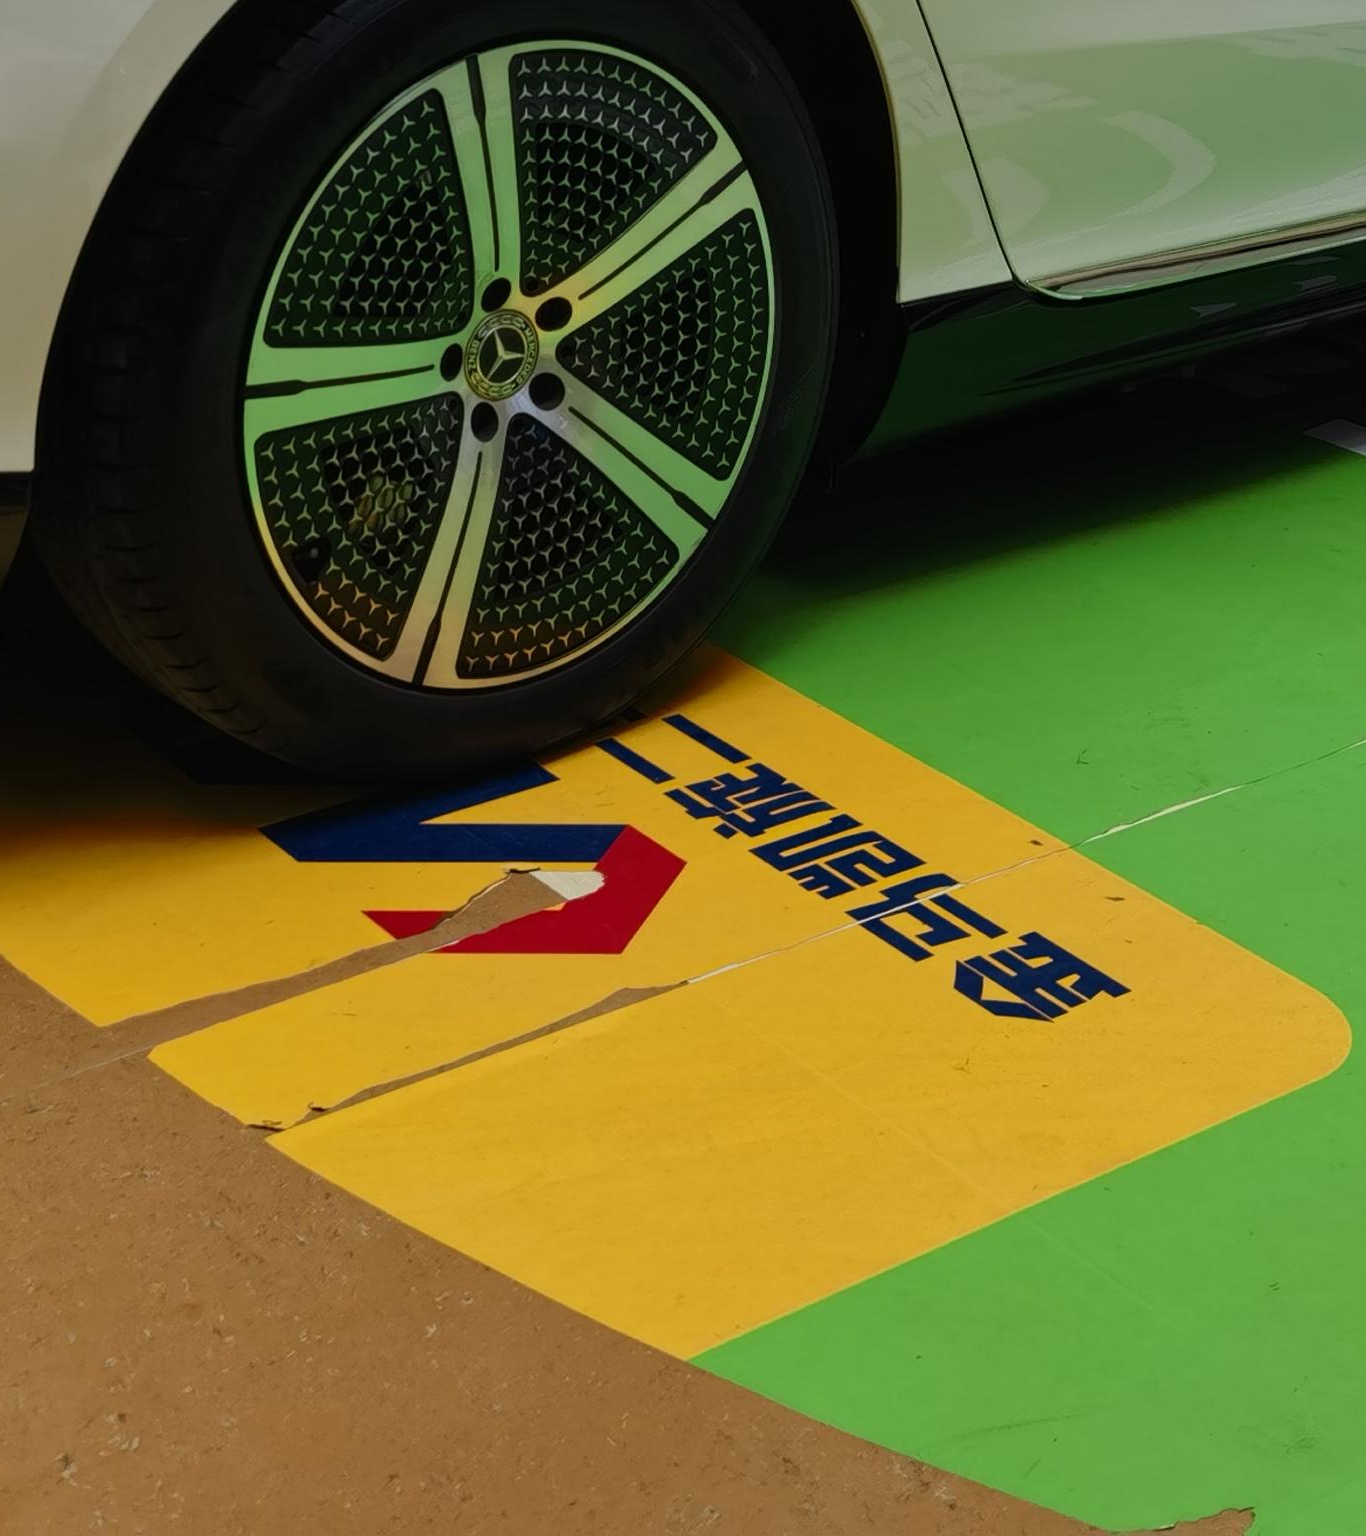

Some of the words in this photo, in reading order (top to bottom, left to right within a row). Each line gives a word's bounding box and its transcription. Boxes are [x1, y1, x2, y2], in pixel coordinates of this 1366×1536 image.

[467, 339, 480, 372] BENZ
[515, 326, 539, 386] MERCEDES
[593, 710, 1132, 1024] 金马凯旋二
